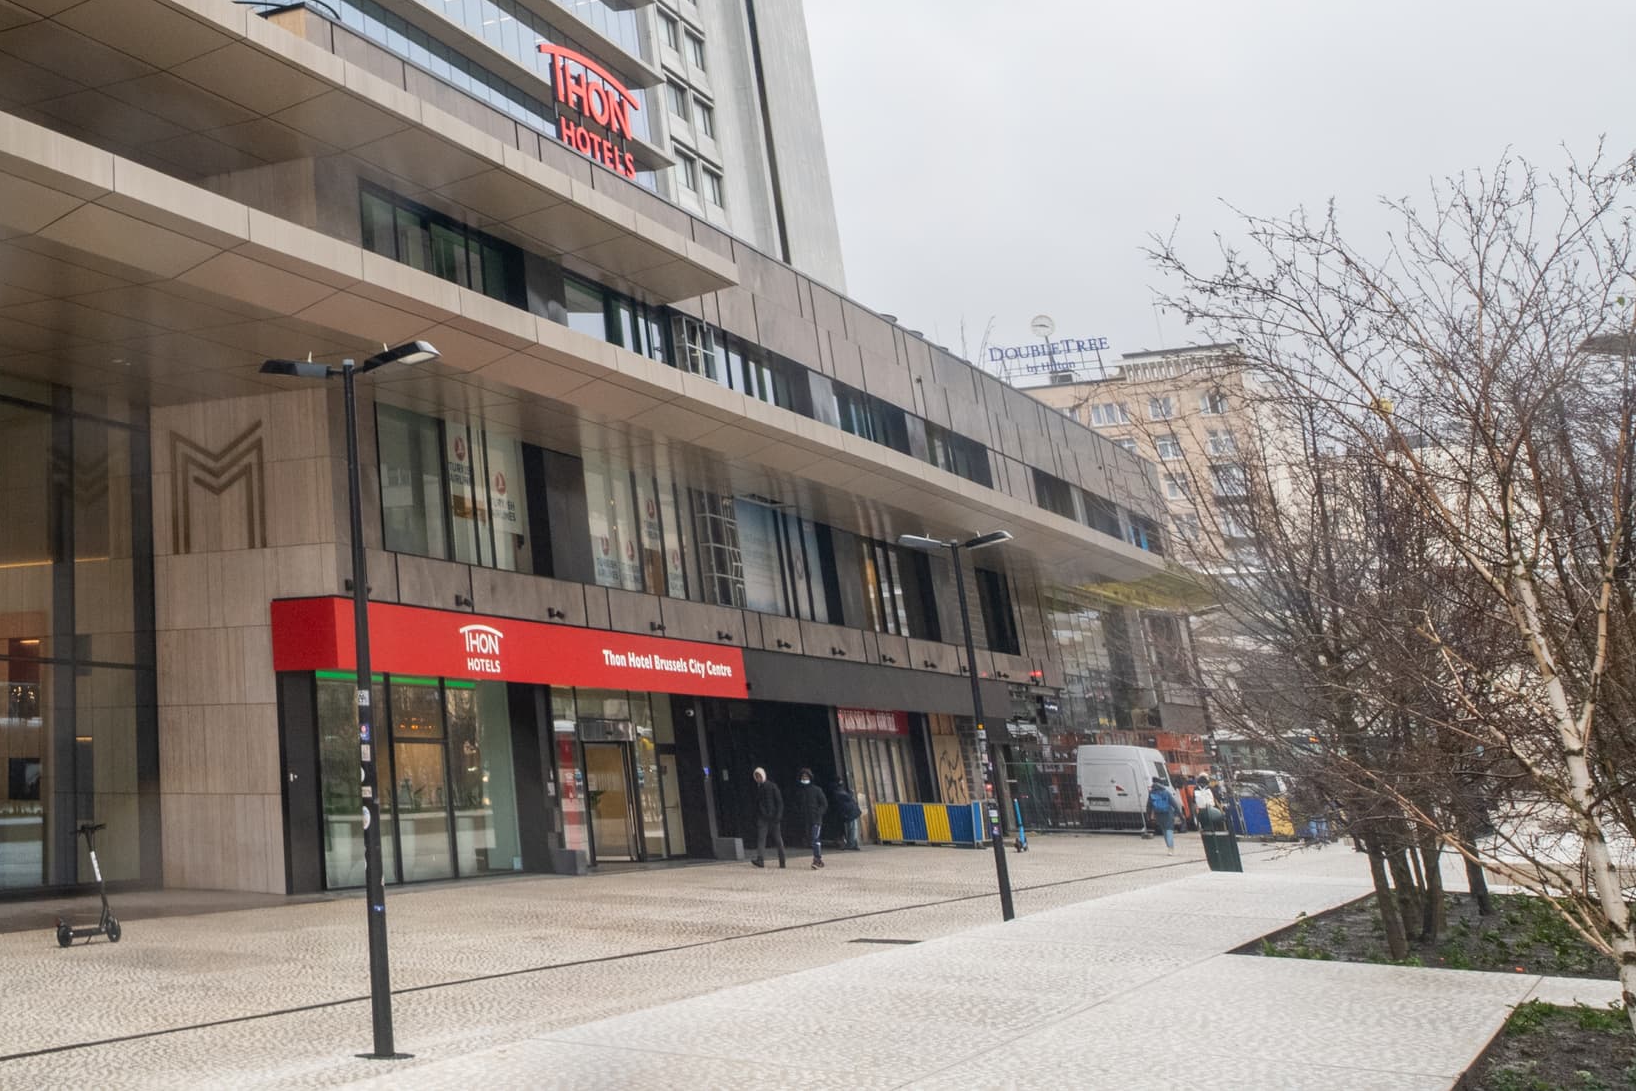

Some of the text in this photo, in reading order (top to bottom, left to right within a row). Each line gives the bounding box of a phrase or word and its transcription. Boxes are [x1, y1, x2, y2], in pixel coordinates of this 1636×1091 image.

[537, 43, 641, 141] THON
[560, 115, 637, 180] HOTELS
[459, 623, 504, 655] THON
[467, 657, 501, 673] HOTELS
[602, 648, 733, 679] Thon Hotel Brussels City Centre
